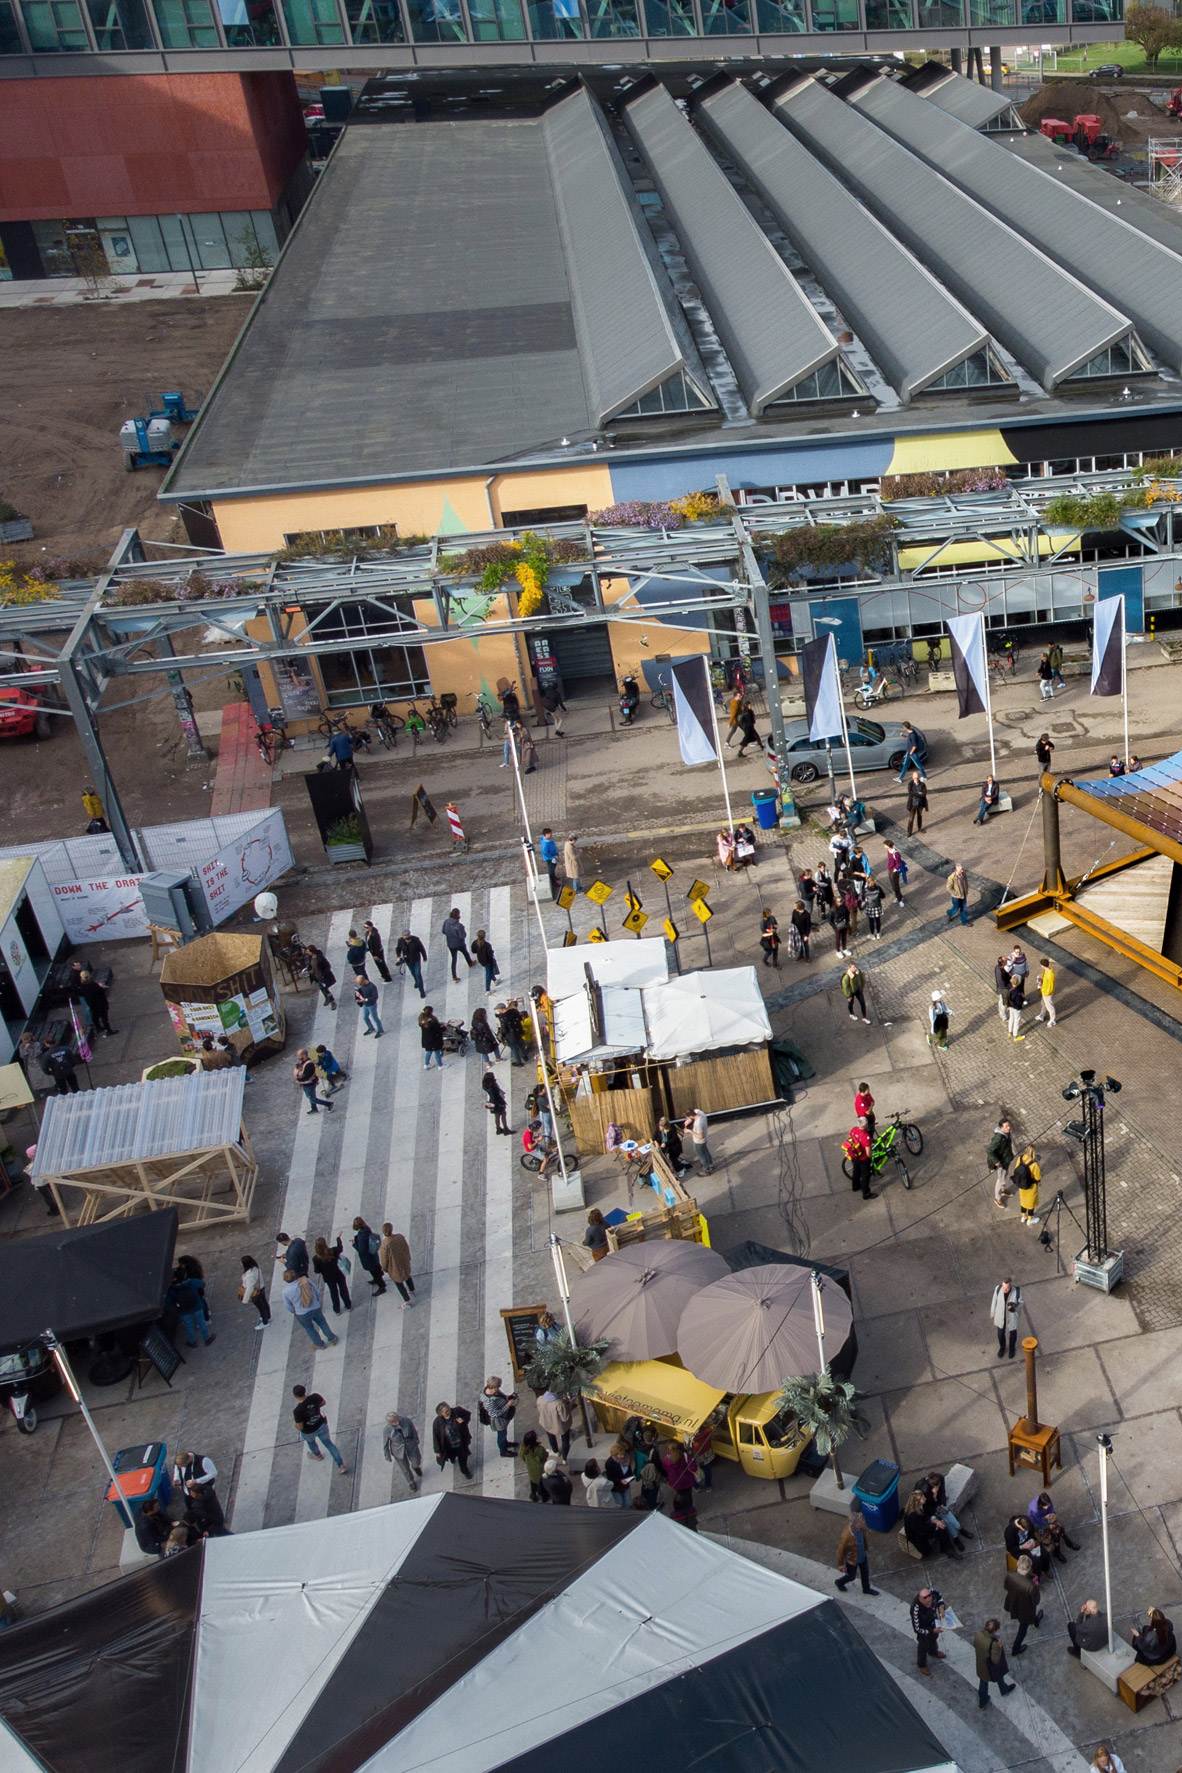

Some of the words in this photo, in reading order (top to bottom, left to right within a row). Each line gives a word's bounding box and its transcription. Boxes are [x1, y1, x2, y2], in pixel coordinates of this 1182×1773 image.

[202, 858, 220, 876] SHIT
[54, 884, 82, 895] DOWN
[88, 881, 109, 891] THE
[115, 878, 144, 888] DRAI
[205, 877, 215, 889] IS
[215, 867, 229, 882] THE
[209, 883, 226, 900] SHIT
